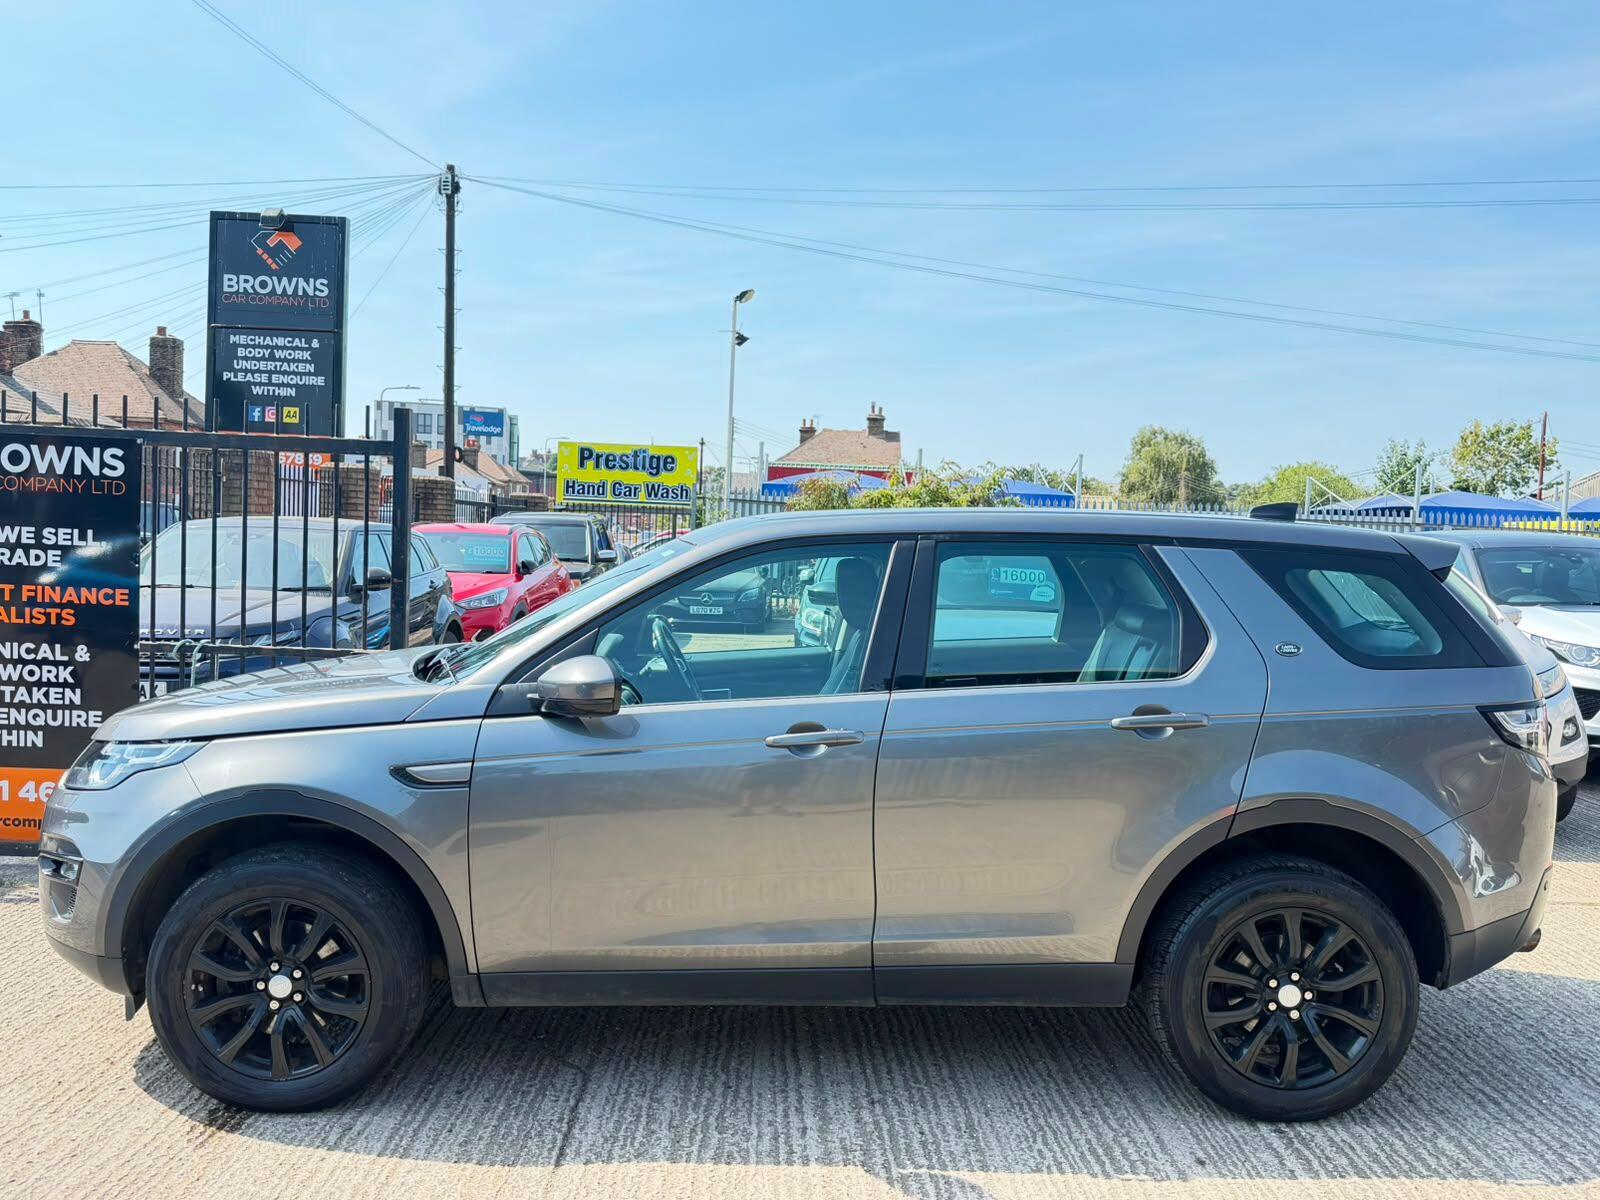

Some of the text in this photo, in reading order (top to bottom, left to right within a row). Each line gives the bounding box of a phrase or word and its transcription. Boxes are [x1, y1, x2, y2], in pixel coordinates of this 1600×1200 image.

[223, 273, 329, 297] BROWNS
[222, 293, 329, 309] CAR COMPANY LTD
[229, 334, 320, 348] MECHANICAL &
[237, 347, 311, 361] BODY WORK
[233, 359, 315, 373] UNDERTAKEN
[223, 371, 325, 386] PLEASE ENQUIRE
[251, 385, 296, 397] WITHIN
[284, 409, 298, 420] AA
[465, 423, 502, 434] Travelodge
[0, 443, 125, 477] OWNS
[578, 445, 678, 477] Prestige
[91, 479, 127, 496] LTD
[564, 479, 691, 502] Hand Car Wash
[0, 525, 36, 544] WE
[991, 566, 1046, 583] £16000
[22, 584, 130, 607] FINANCE
[0, 642, 91, 662] NICAL &
[0, 664, 75, 683] WORK
[0, 686, 81, 706] TAKEN
[0, 729, 44, 748] HIN
